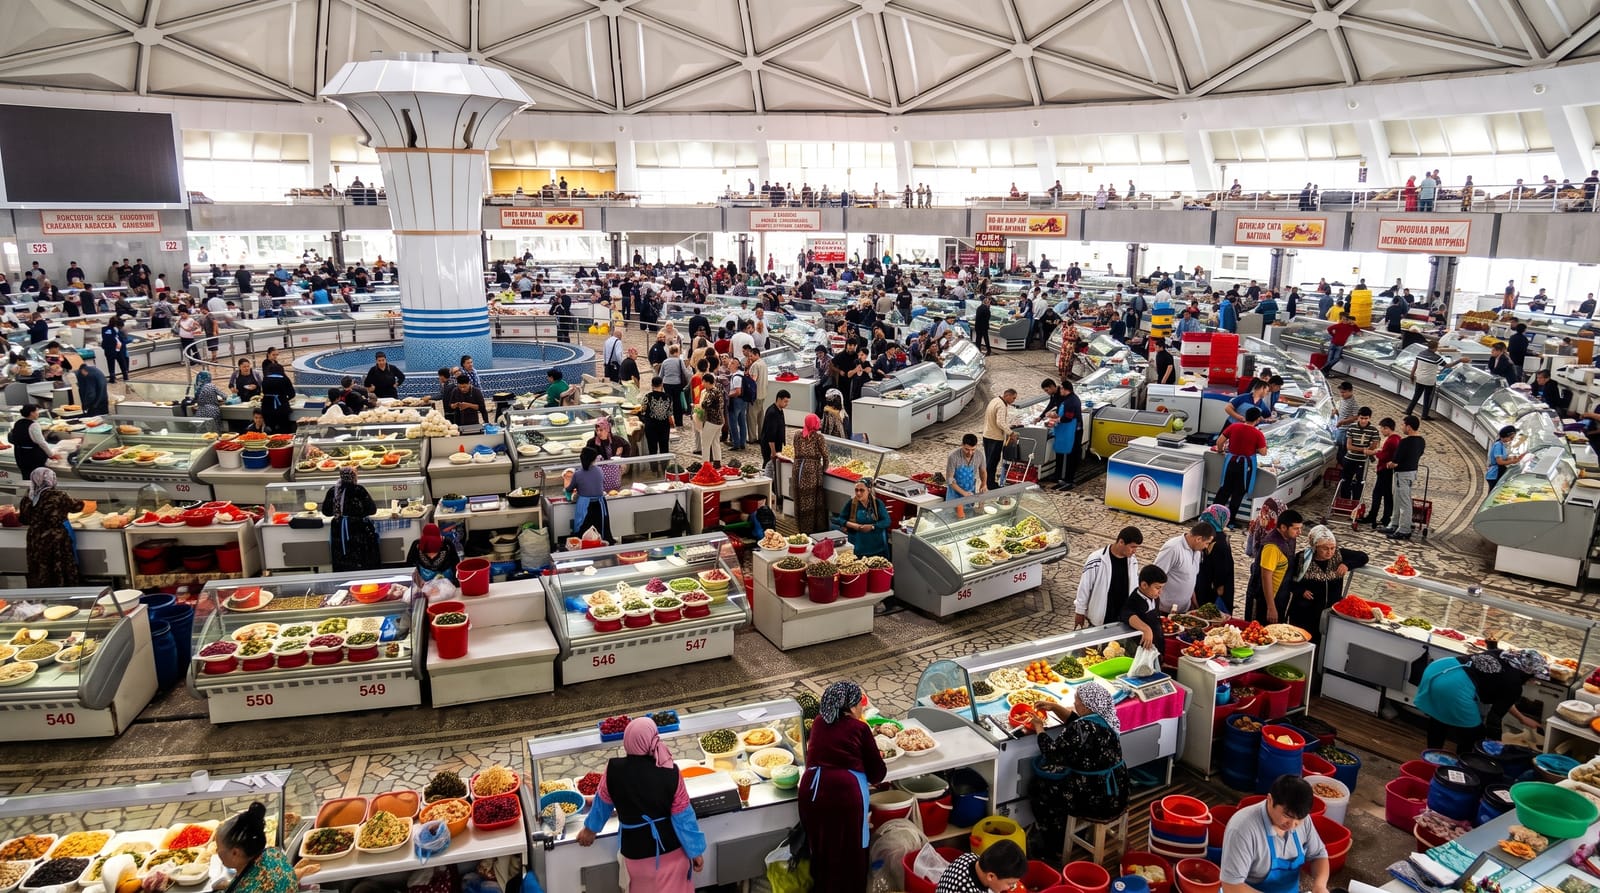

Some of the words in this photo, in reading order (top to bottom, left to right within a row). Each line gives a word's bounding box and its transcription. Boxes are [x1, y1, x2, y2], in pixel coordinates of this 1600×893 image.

[1013, 572, 1027, 583] 545
[957, 588, 972, 600] 545
[685, 638, 707, 651] 547
[592, 653, 616, 667] 546
[359, 683, 386, 696] 549
[246, 693, 274, 707] 550
[46, 712, 76, 726] 540
